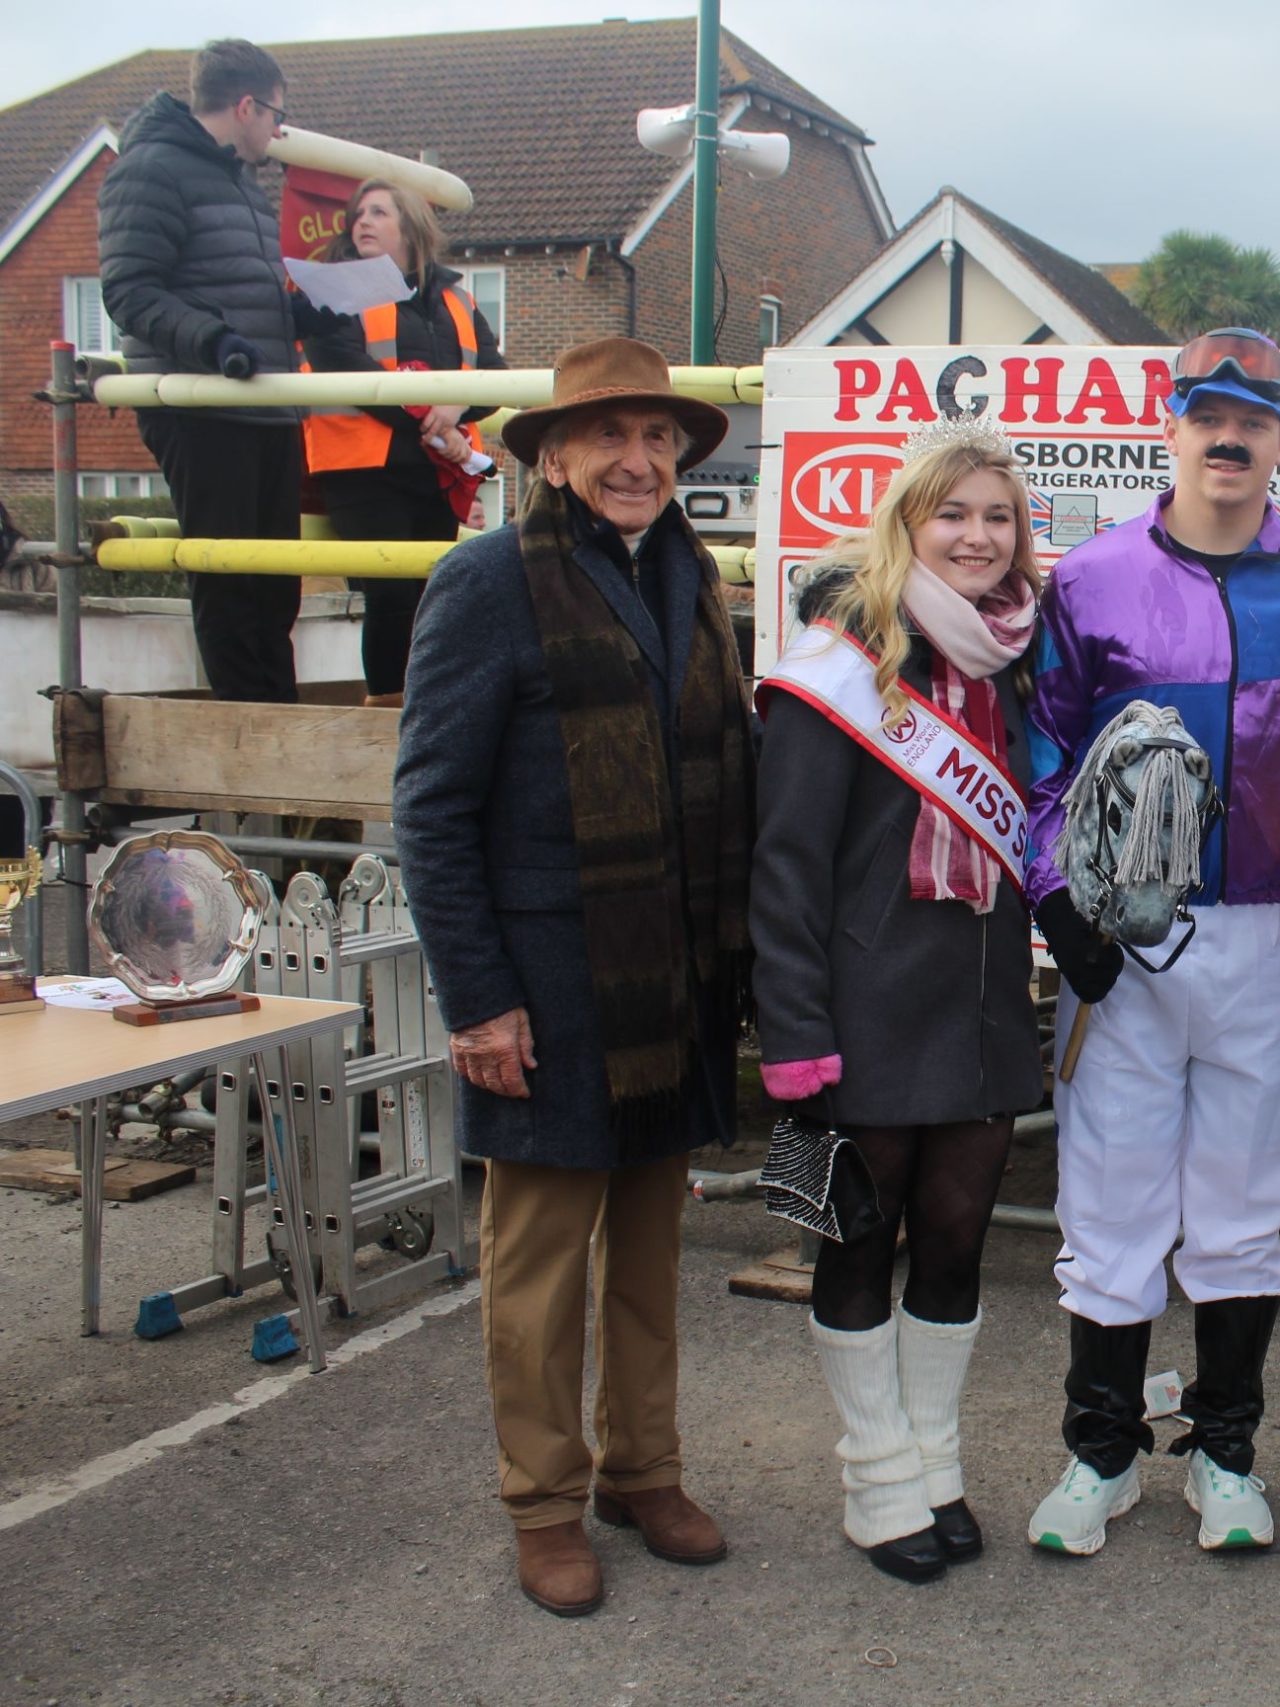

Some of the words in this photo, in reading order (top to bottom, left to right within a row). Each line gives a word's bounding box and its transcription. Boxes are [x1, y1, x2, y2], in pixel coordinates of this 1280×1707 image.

[1014, 442, 1171, 470] SBORNE
[818, 467, 904, 515] KI
[906, 724, 942, 768] ENGLAND
[936, 746, 1016, 837] MISS
